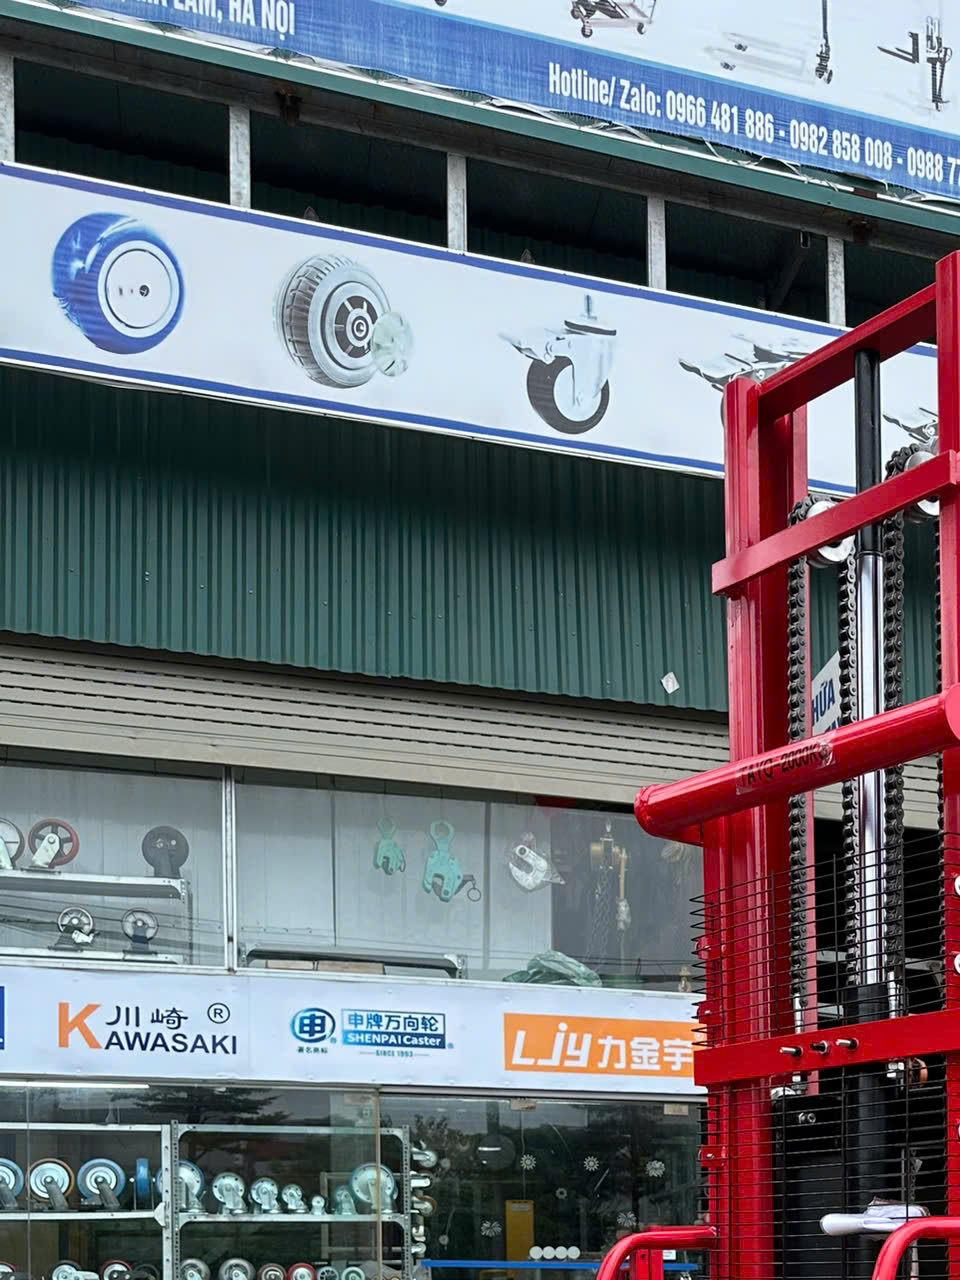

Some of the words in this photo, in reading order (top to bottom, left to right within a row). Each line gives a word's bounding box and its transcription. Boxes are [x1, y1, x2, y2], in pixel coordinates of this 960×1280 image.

[548, 61, 616, 108] Hotline/
[619, 79, 661, 118] Zalo:
[665, 90, 706, 129] 0966
[711, 101, 739, 136] 481
[745, 108, 774, 144] 886
[790, 119, 829, 156] 0982
[832, 129, 861, 164] 858
[864, 137, 893, 171] 008
[907, 147, 943, 183] 0988
[57, 1001, 238, 1055] KAWASAKI
[348, 1012, 439, 1032] 申牌万向轮
